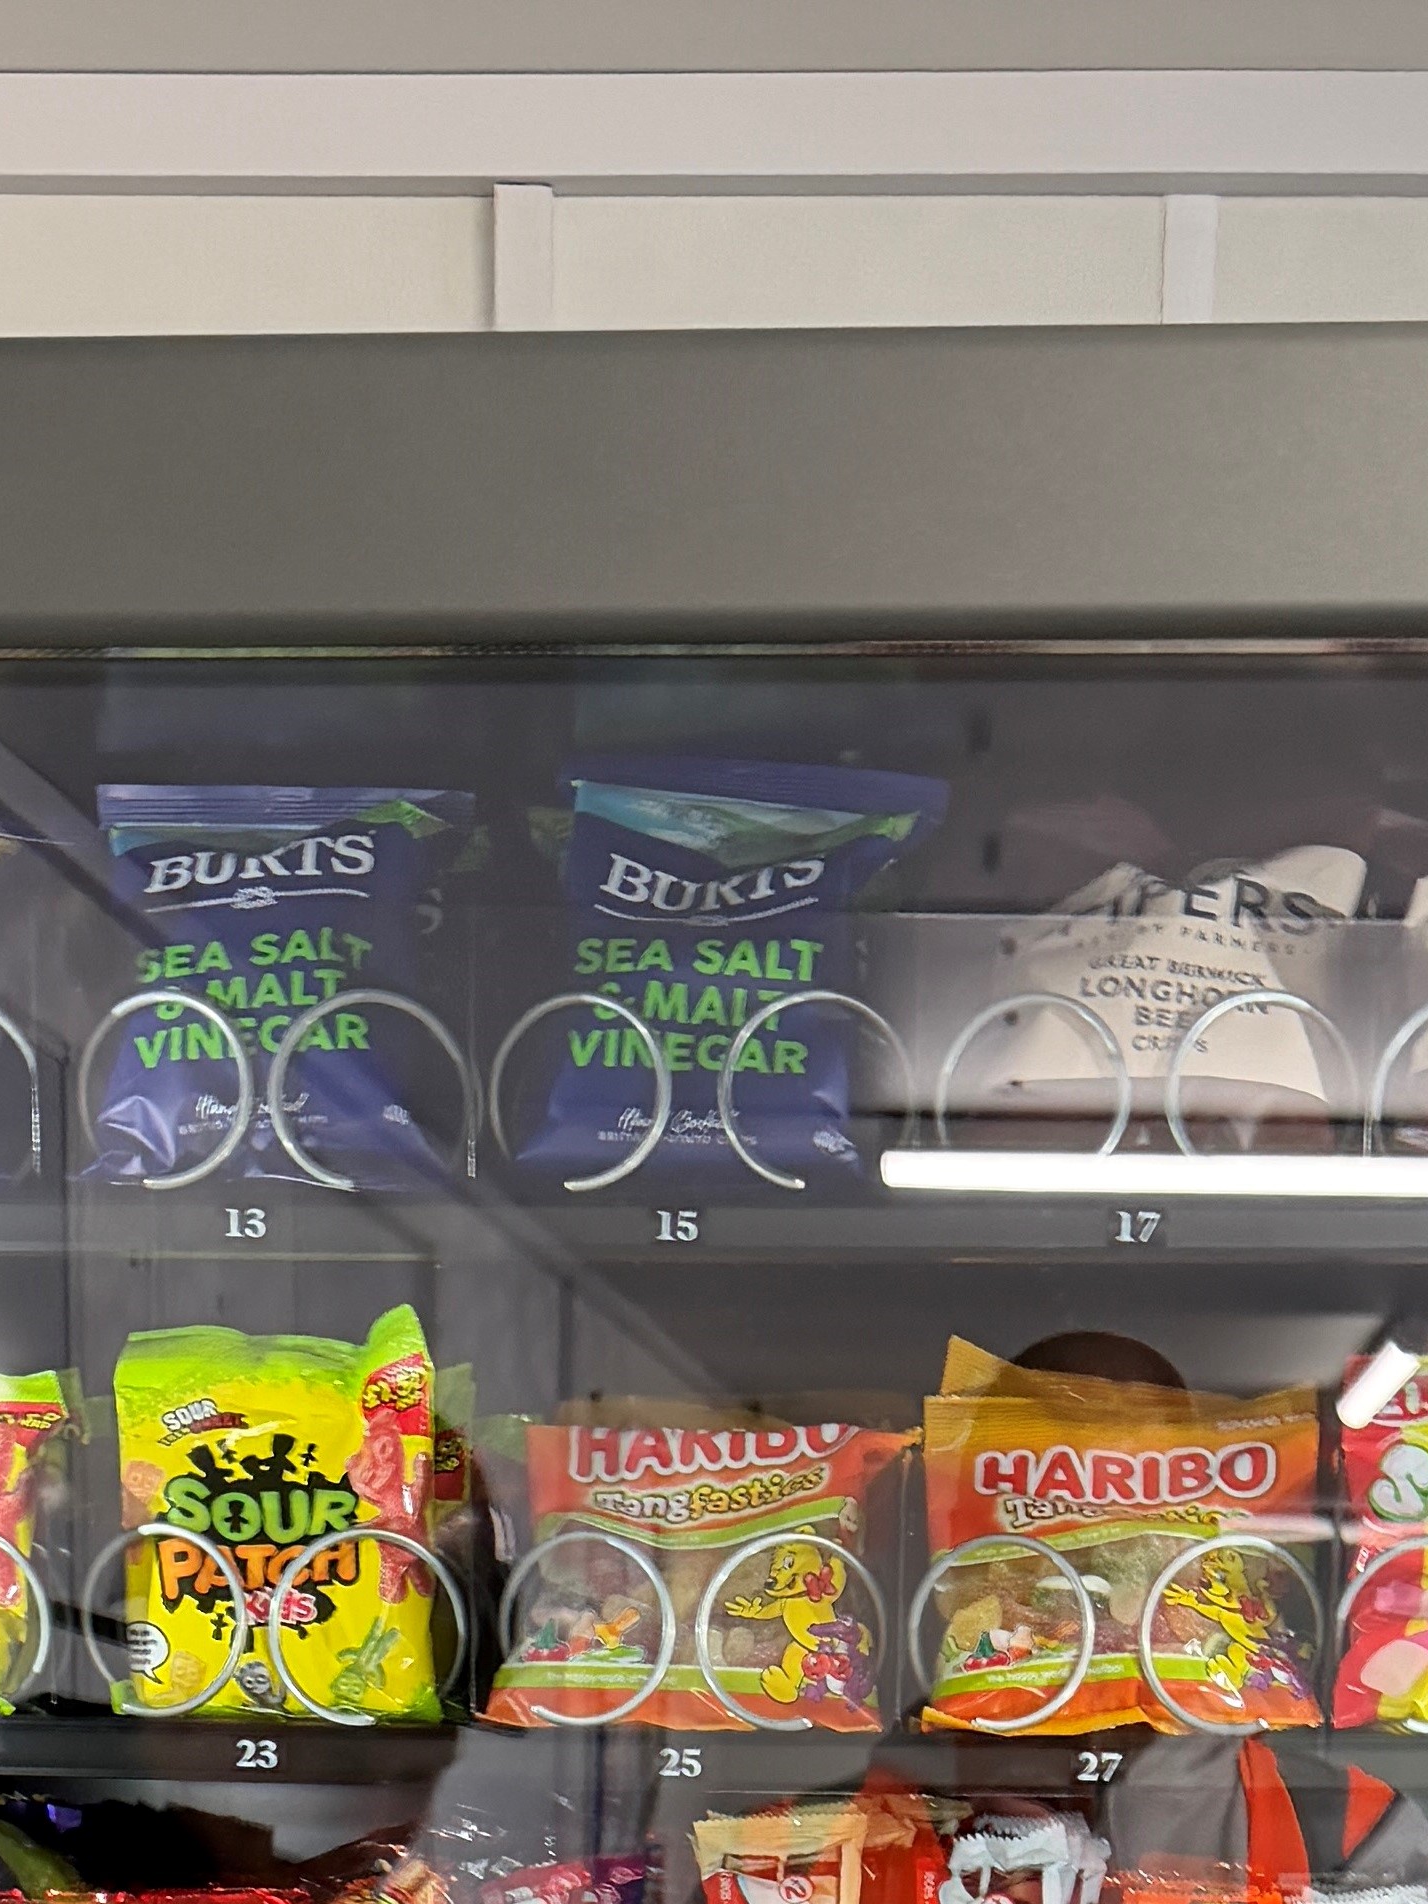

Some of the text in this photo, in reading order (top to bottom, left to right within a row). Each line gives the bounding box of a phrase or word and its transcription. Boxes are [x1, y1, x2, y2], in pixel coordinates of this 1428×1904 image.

[136, 926, 373, 984] SEA SALT
[574, 937, 825, 983] SEA SALT
[205, 968, 347, 1009] MALT
[224, 1208, 266, 1240] 13
[655, 1209, 699, 1243] 15
[1114, 1208, 1162, 1245] 17
[974, 1442, 1277, 1505] HARIBO
[165, 1477, 358, 1544] SOUR
[235, 1738, 279, 1771] 23
[657, 1749, 703, 1779] 25
[1077, 1751, 1123, 1783] 27
